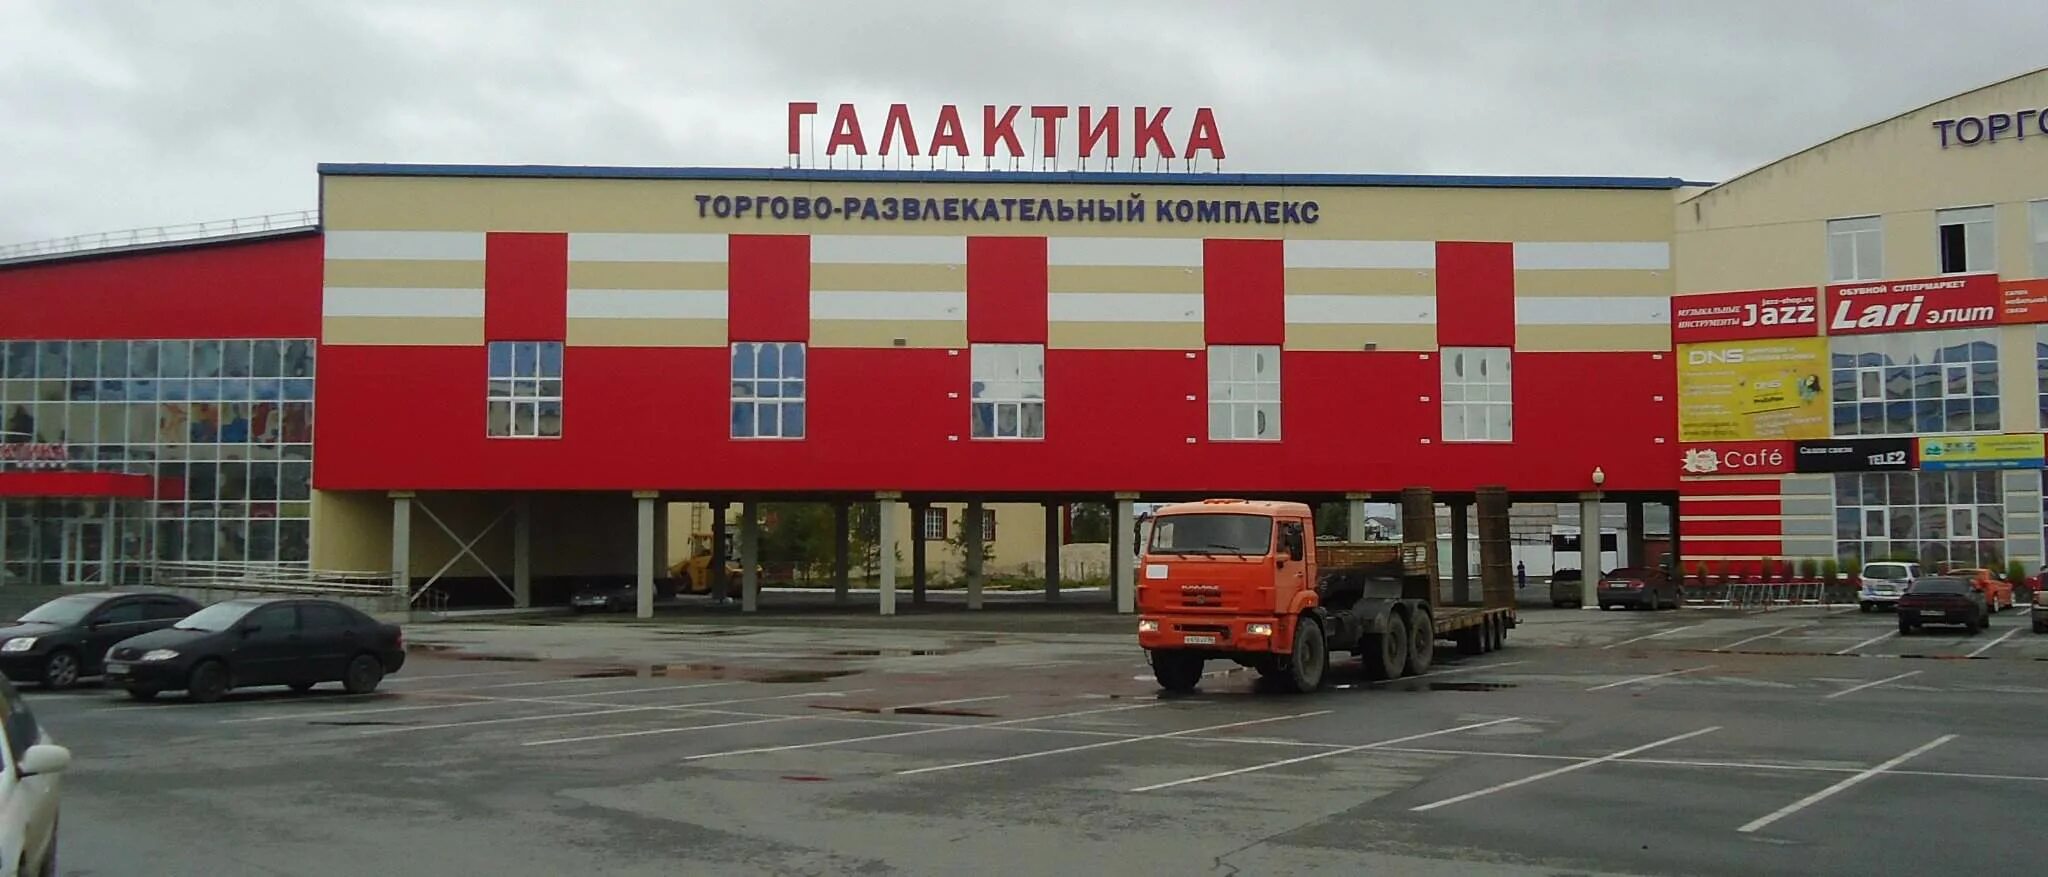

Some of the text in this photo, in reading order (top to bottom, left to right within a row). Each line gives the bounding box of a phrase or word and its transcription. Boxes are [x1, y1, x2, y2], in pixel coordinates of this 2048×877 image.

[787, 102, 1226, 159] ГАЛАКТИКА
[695, 193, 1320, 225] ТОРГОВО-РАЗВЛЕКАТЕЛЬНЫЙ КОМПЛЕКС
[1839, 280, 1967, 296] ОБУВНОЙ СУПЕРМАРКЕТ
[1678, 306, 1741, 317] МУЗЫКАЛЬНЫЕ
[1742, 303, 1815, 327] Jazz
[1831, 296, 1994, 329] Lari элит
[1678, 318, 1740, 329] ИНСТРУМЕНТЫ
[1689, 349, 1744, 365] DNS
[1724, 448, 1783, 468] Café
[1867, 450, 1906, 466] TELE2
